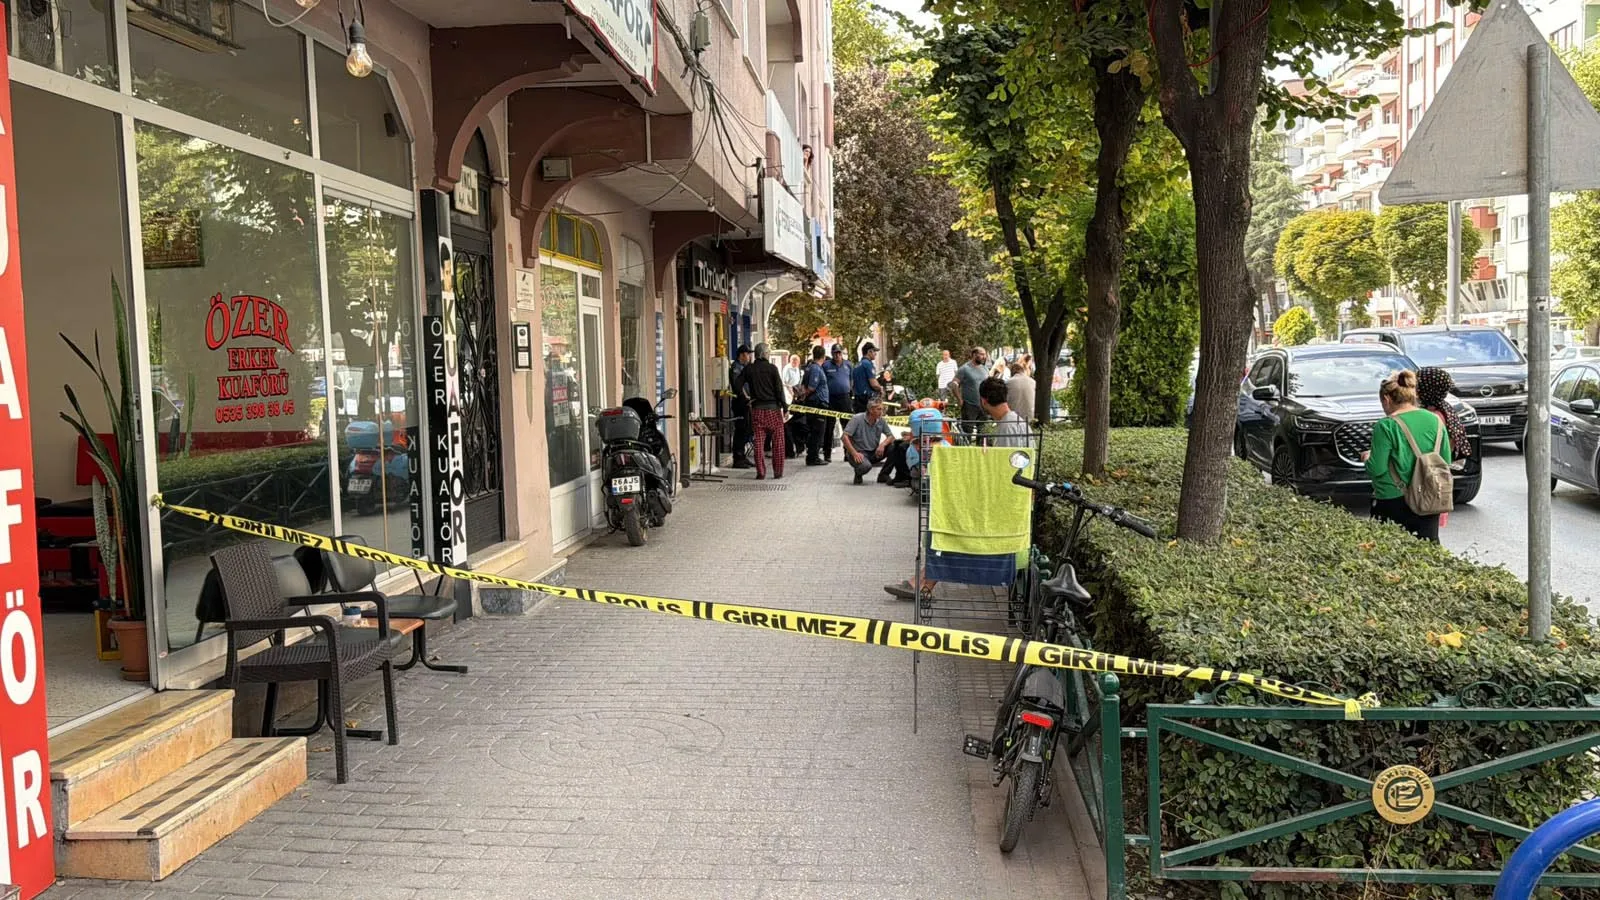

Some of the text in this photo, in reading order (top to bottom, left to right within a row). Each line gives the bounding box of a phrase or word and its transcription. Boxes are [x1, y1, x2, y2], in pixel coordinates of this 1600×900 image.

[205, 292, 294, 354] ÖZER
[217, 369, 290, 400] KUAFÖRÜ
[227, 347, 279, 371] ERKEK
[430, 317, 454, 563] ÖZER KUAFÖR
[442, 296, 466, 548] KUAFÖR
